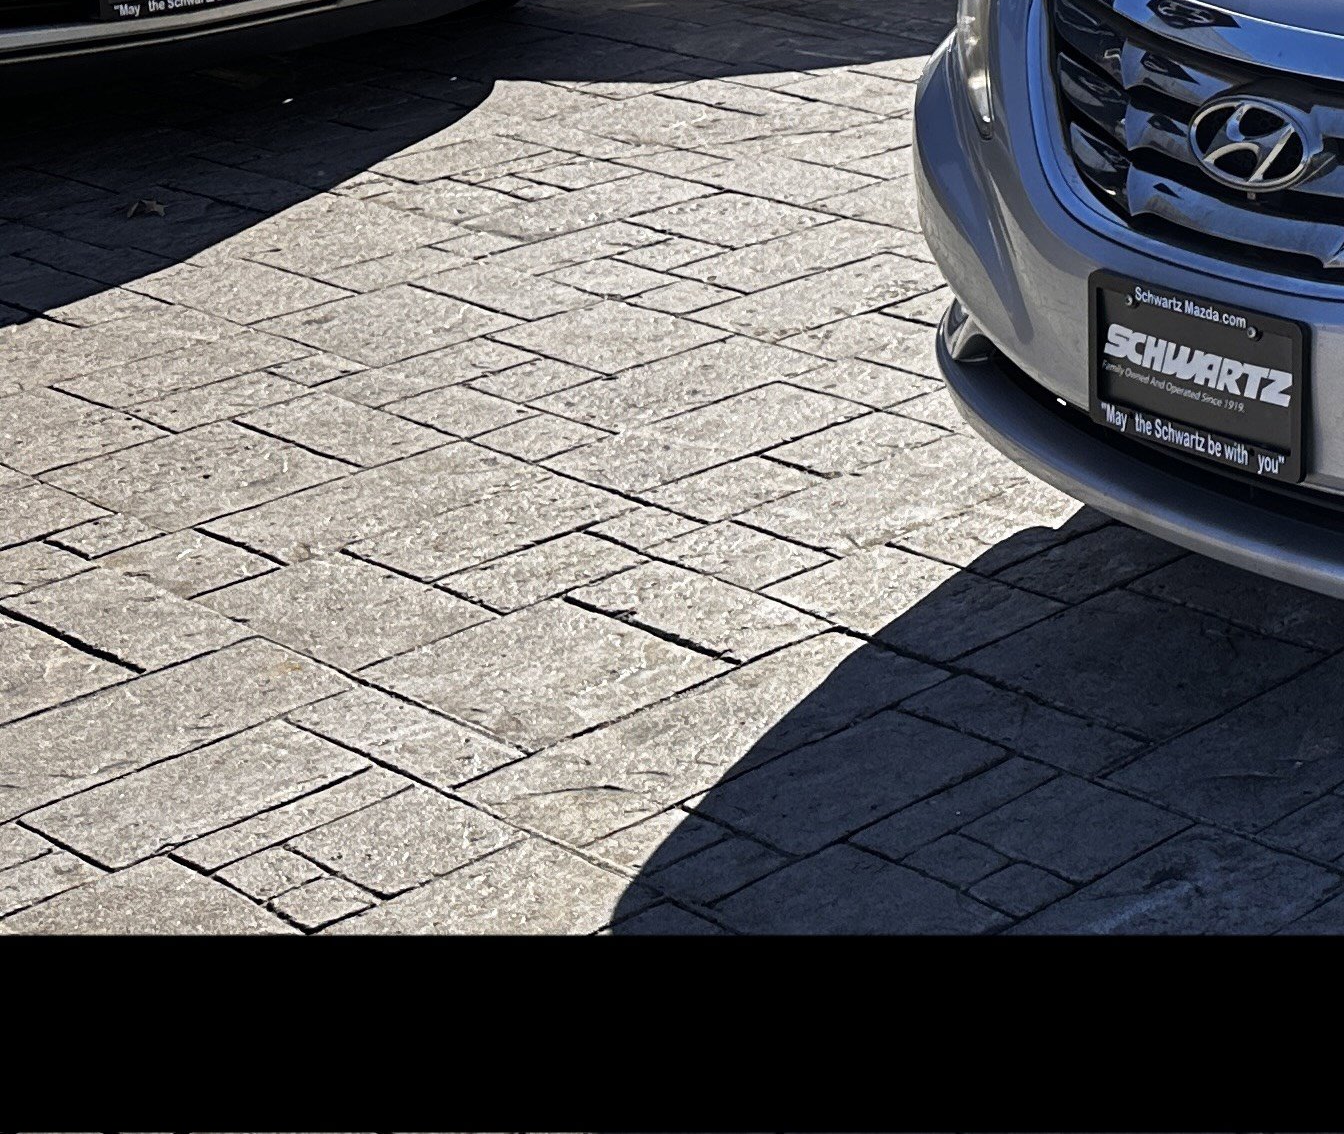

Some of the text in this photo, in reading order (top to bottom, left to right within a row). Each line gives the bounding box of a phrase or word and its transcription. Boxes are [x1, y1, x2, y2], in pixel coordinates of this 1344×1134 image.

[113, 3, 141, 18] "May
[1134, 286, 1247, 329] Schwartz Mazda.com
[1102, 360, 1124, 377] Family
[1125, 369, 1150, 385] Owned
[1150, 376, 1165, 389] And
[1165, 382, 1201, 402] Operated
[1201, 391, 1222, 408] Since
[1103, 323, 1293, 408] SCHWARTZ
[1101, 402, 1285, 475] "May the Schwartz be with you"
